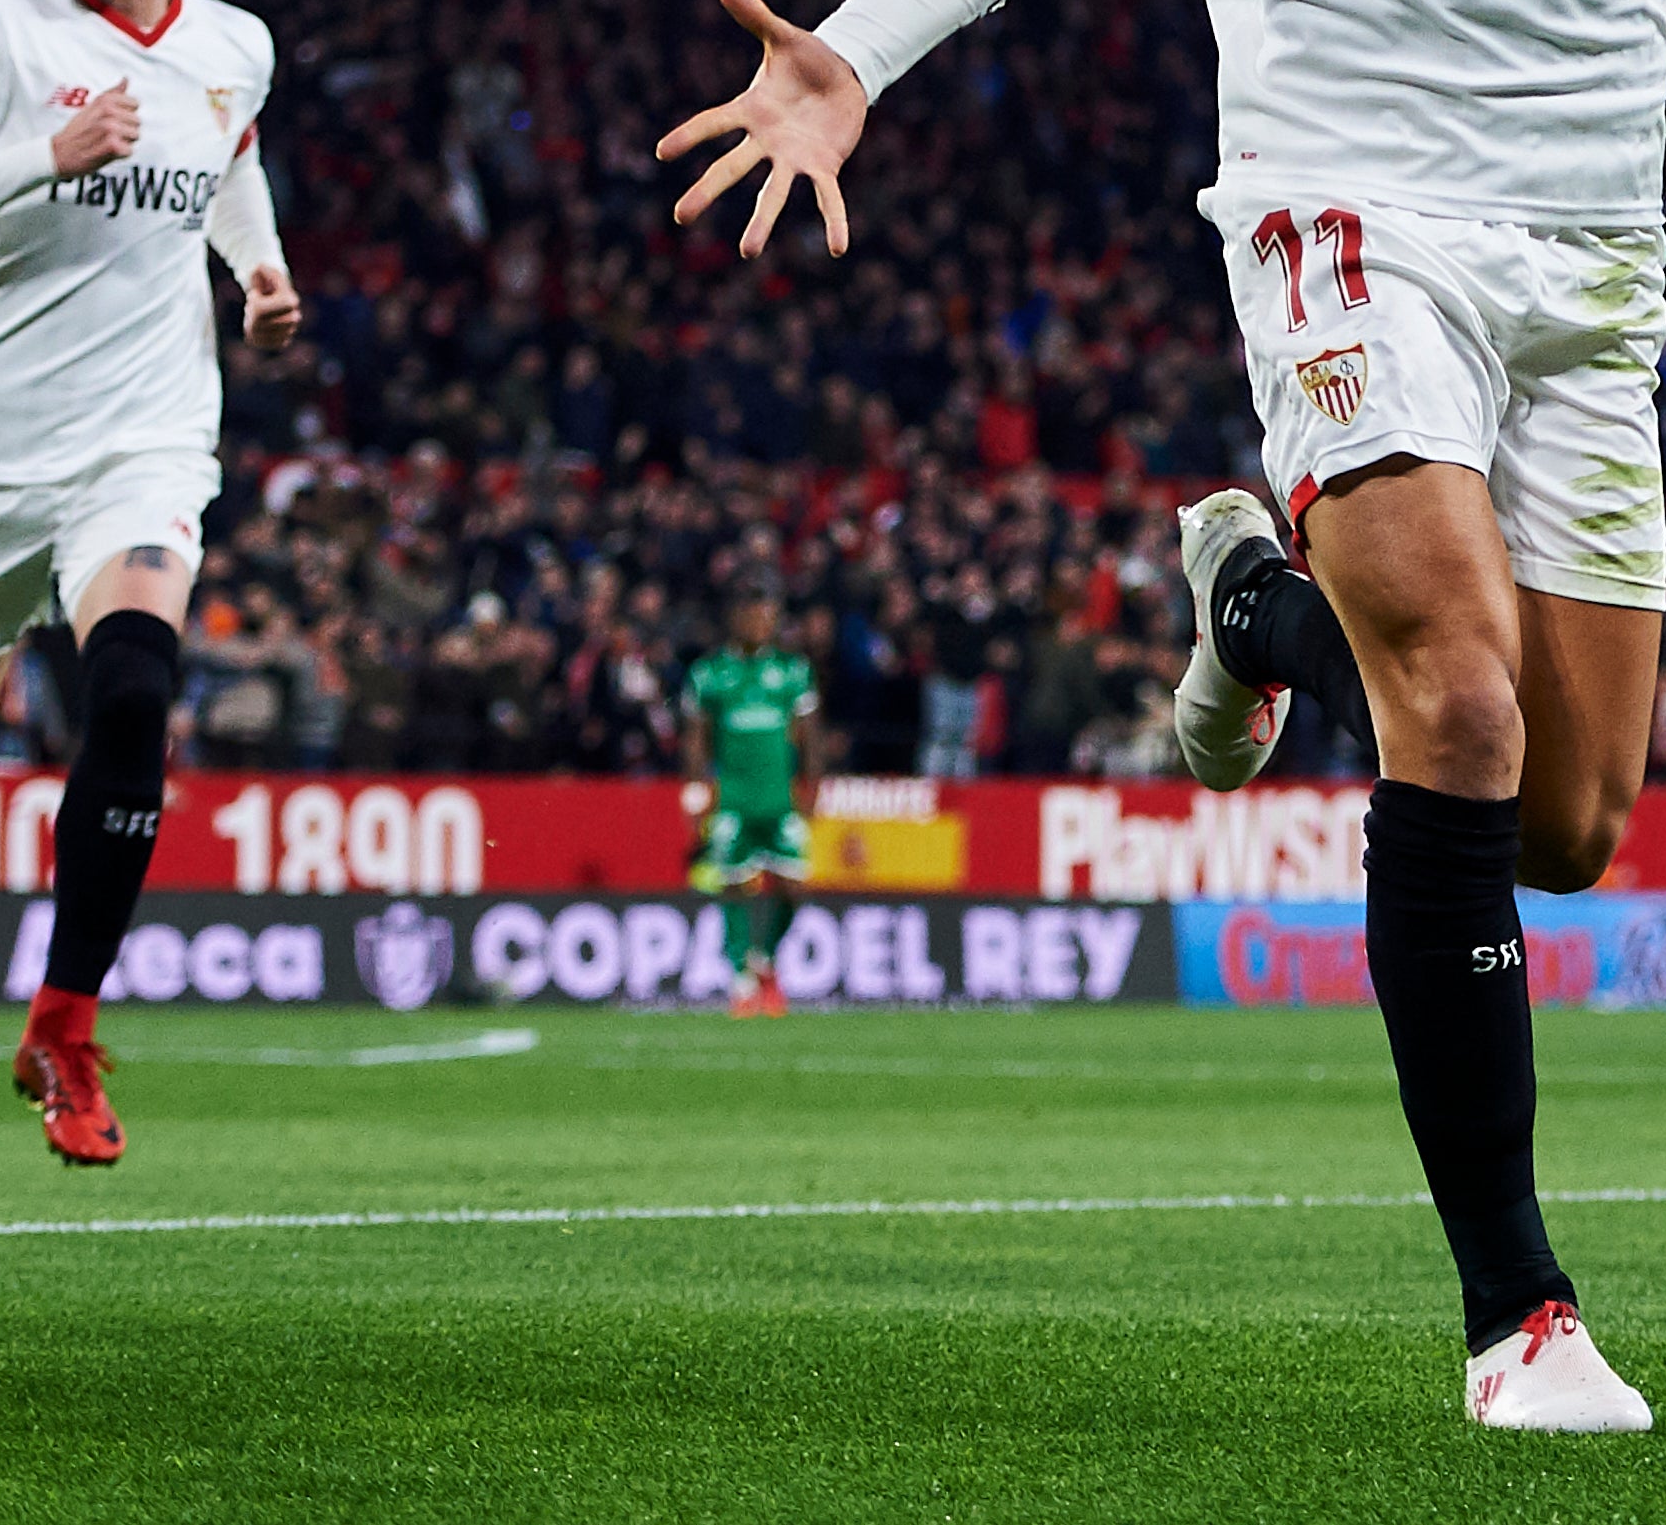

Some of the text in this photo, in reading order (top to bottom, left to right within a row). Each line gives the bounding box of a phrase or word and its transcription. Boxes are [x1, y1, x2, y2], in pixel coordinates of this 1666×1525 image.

[1251, 207, 1371, 334] 11
[779, 903, 945, 1001] DEL
[962, 905, 1143, 1002] REY
